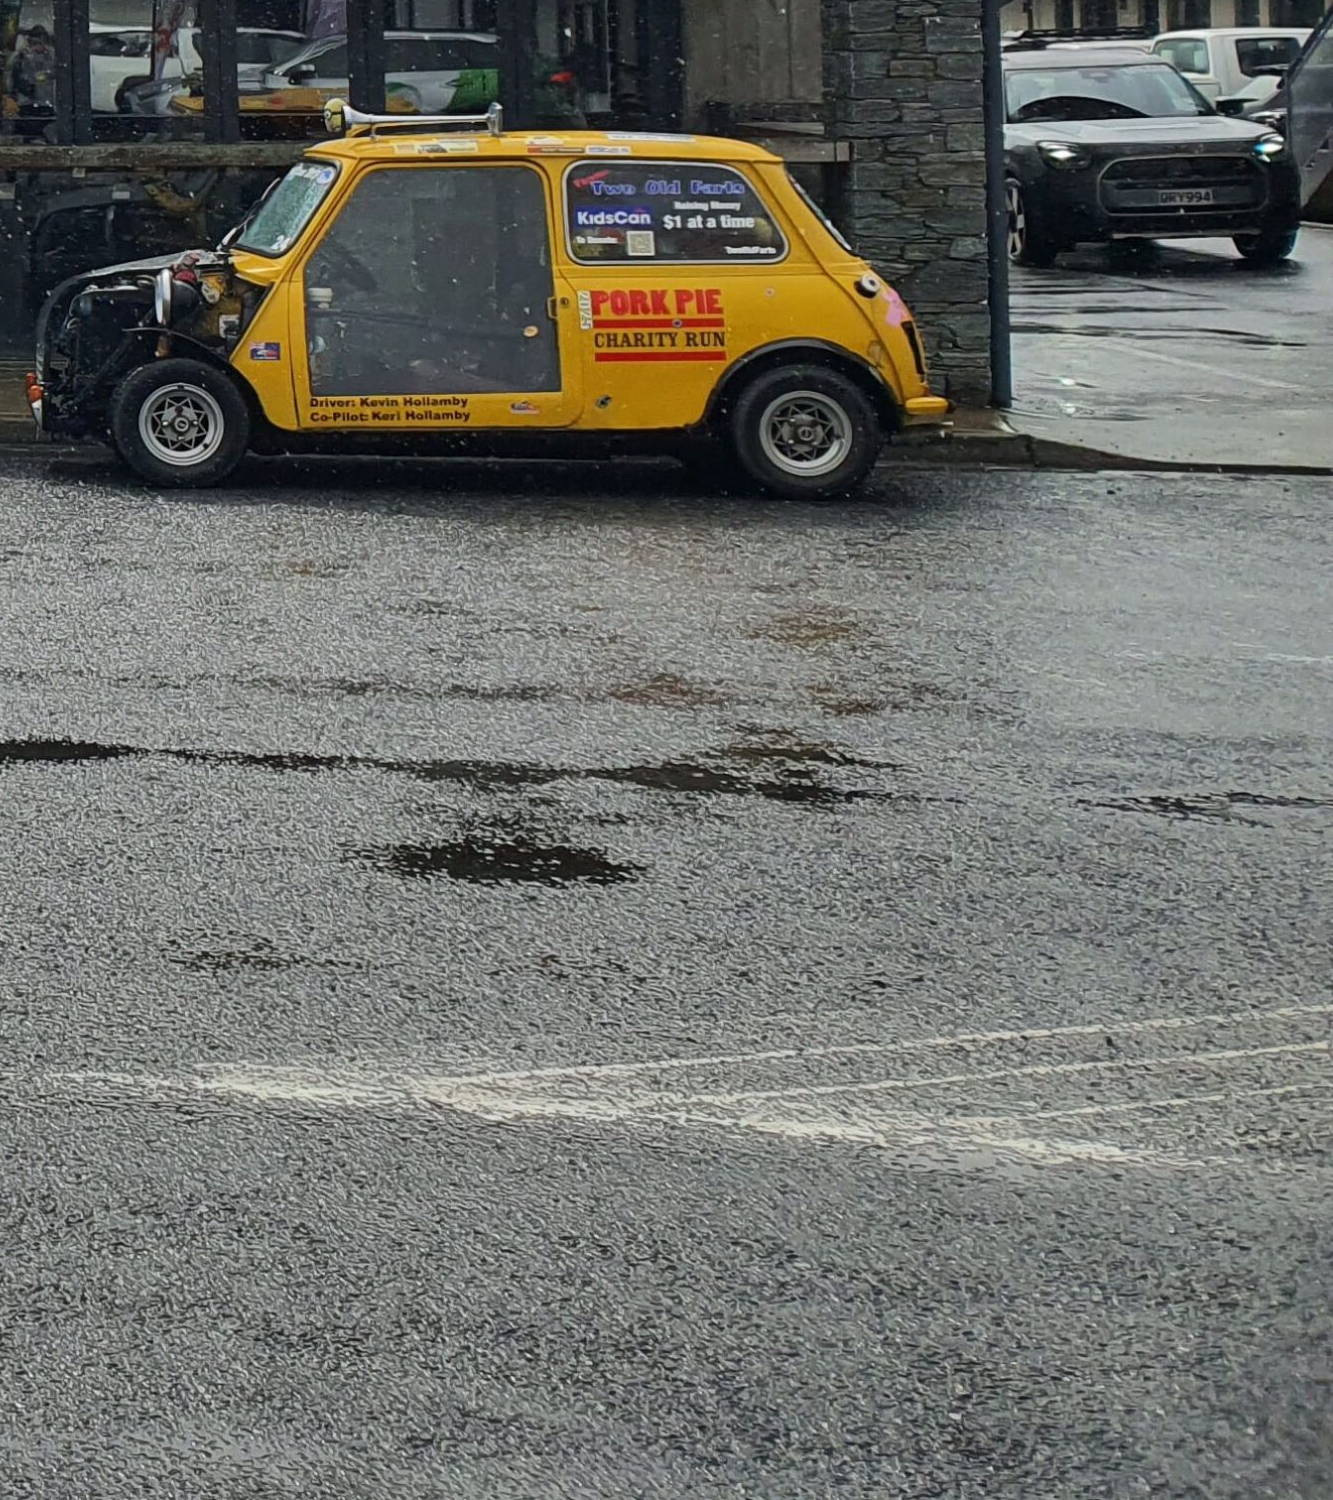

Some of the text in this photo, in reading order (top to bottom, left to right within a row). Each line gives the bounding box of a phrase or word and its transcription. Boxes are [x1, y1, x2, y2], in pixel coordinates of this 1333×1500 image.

[577, 211, 651, 225] KidsCan
[663, 214, 755, 230] $1 at a time
[591, 289, 724, 316] PORK PIE
[594, 331, 726, 348] CHARITY RUN
[310, 396, 468, 408] Driver: Kevin Hollamby
[310, 411, 369, 422] Co-Pilot:
[405, 410, 471, 423] Hollamby
